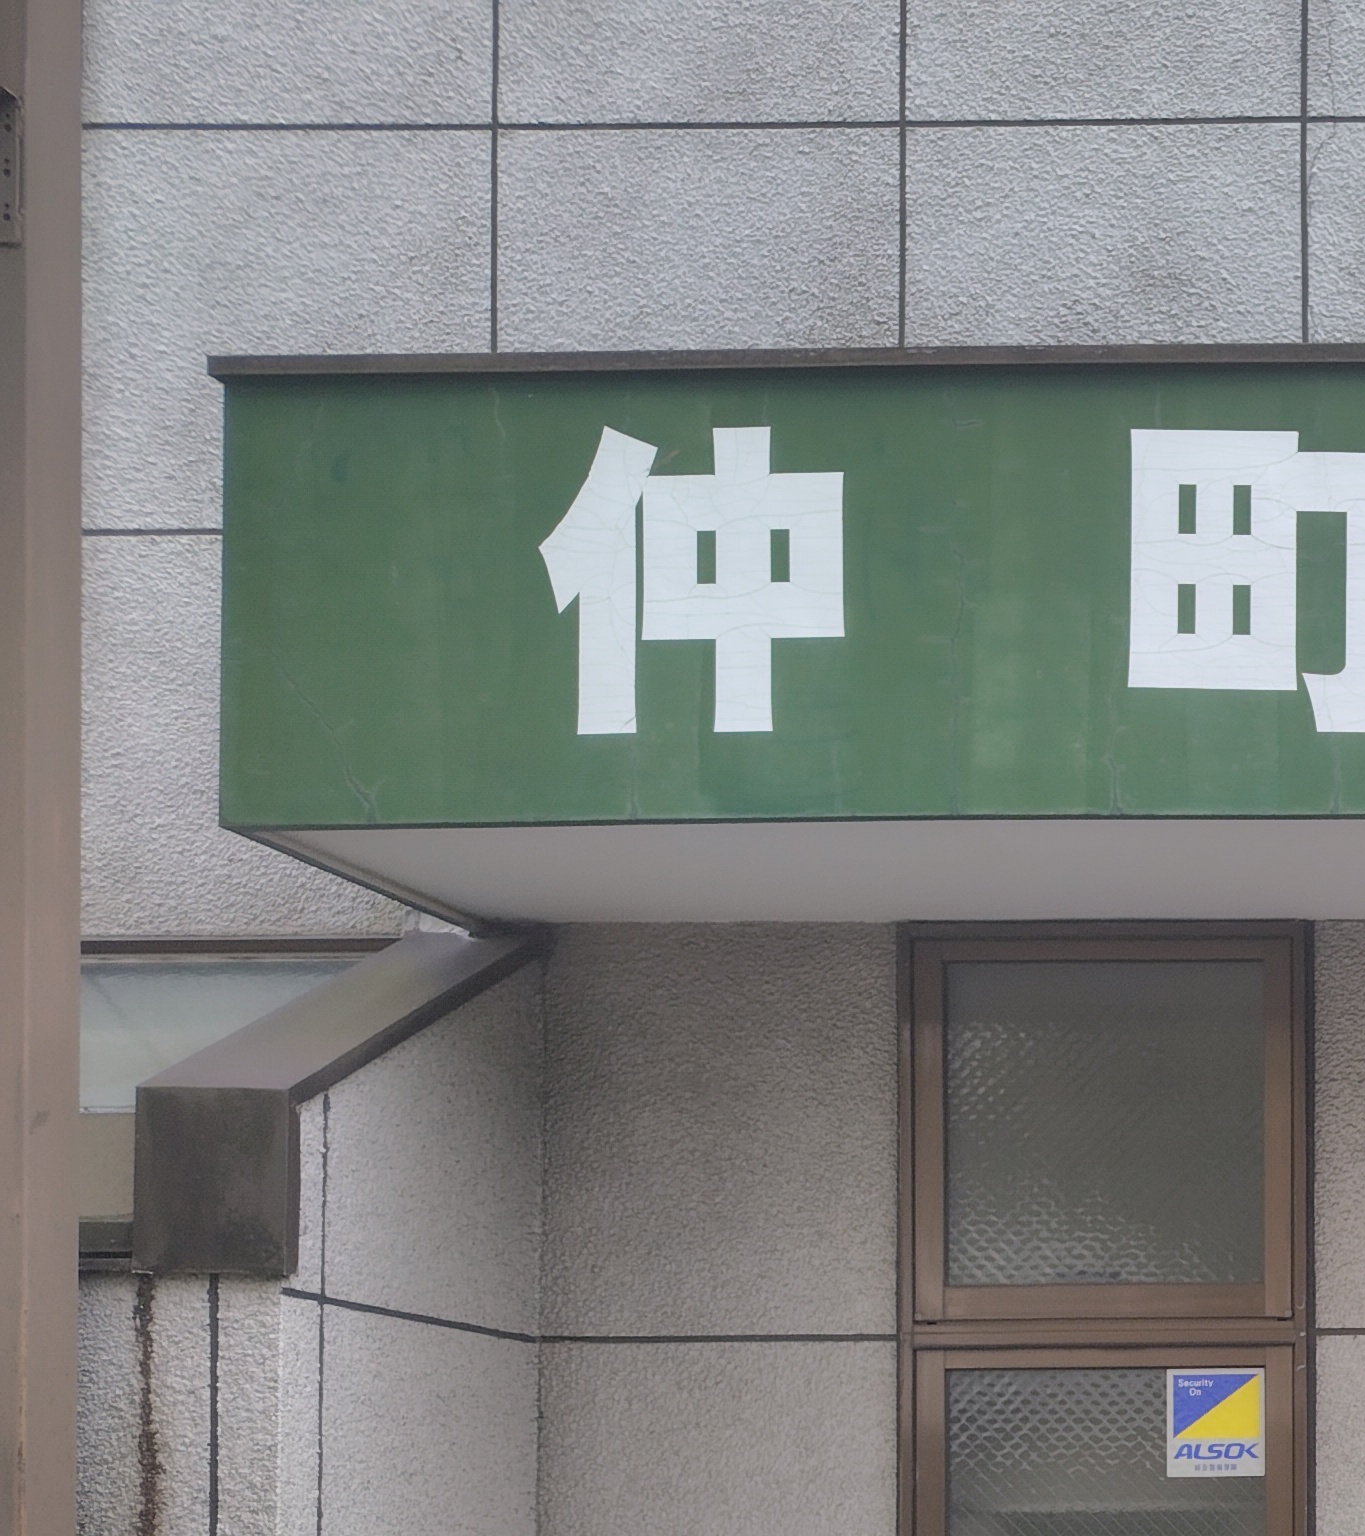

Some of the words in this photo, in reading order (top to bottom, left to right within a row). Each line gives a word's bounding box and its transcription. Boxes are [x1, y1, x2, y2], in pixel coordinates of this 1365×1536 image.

[1178, 1379, 1214, 1388] Security
[1189, 1388, 1202, 1397] On
[1173, 1443, 1260, 1460] ALSOK
